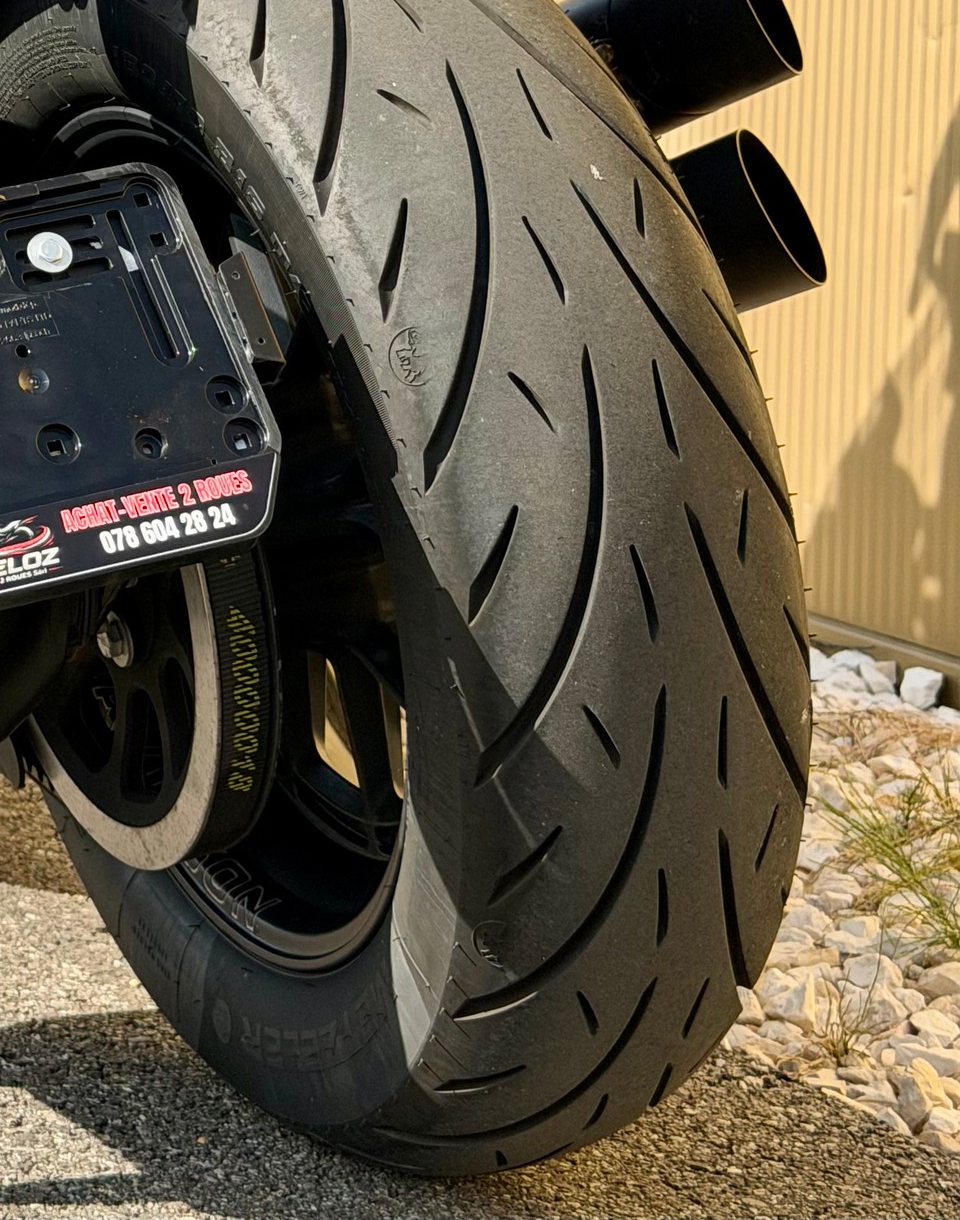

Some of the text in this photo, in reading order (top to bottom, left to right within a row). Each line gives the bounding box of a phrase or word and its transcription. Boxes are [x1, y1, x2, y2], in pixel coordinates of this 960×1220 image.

[60, 471, 252, 533] ACHAT-VENTE 2 ROUES
[99, 504, 236, 555] 078 604 28 24
[6, 570, 33, 583] ROUES
